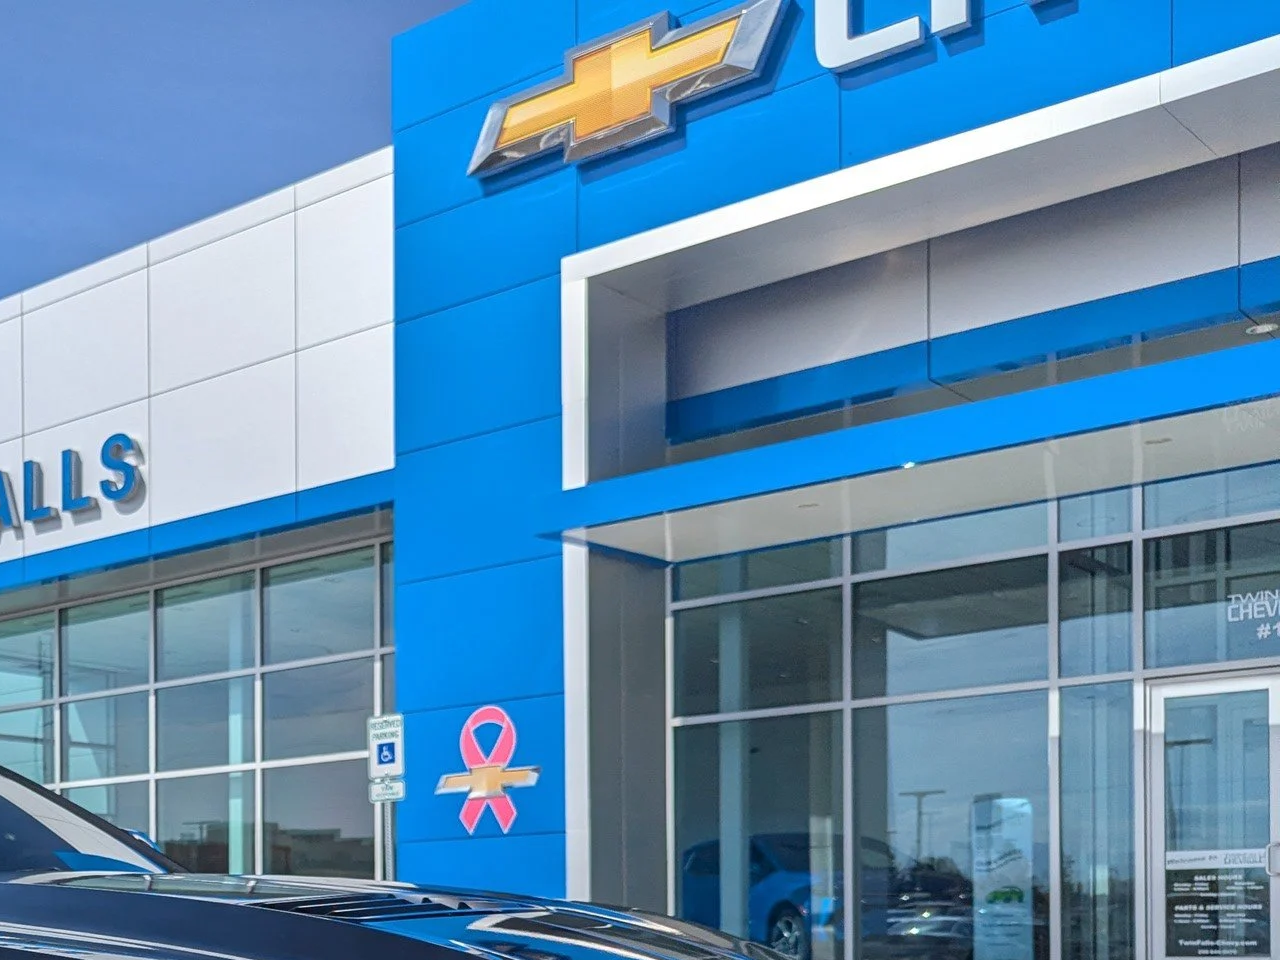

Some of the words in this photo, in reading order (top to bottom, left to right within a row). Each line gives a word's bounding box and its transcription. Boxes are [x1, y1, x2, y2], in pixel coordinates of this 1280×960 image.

[1227, 589, 1279, 604] TWIN
[1227, 600, 1280, 622] CHEV
[372, 731, 400, 740] PARKING
